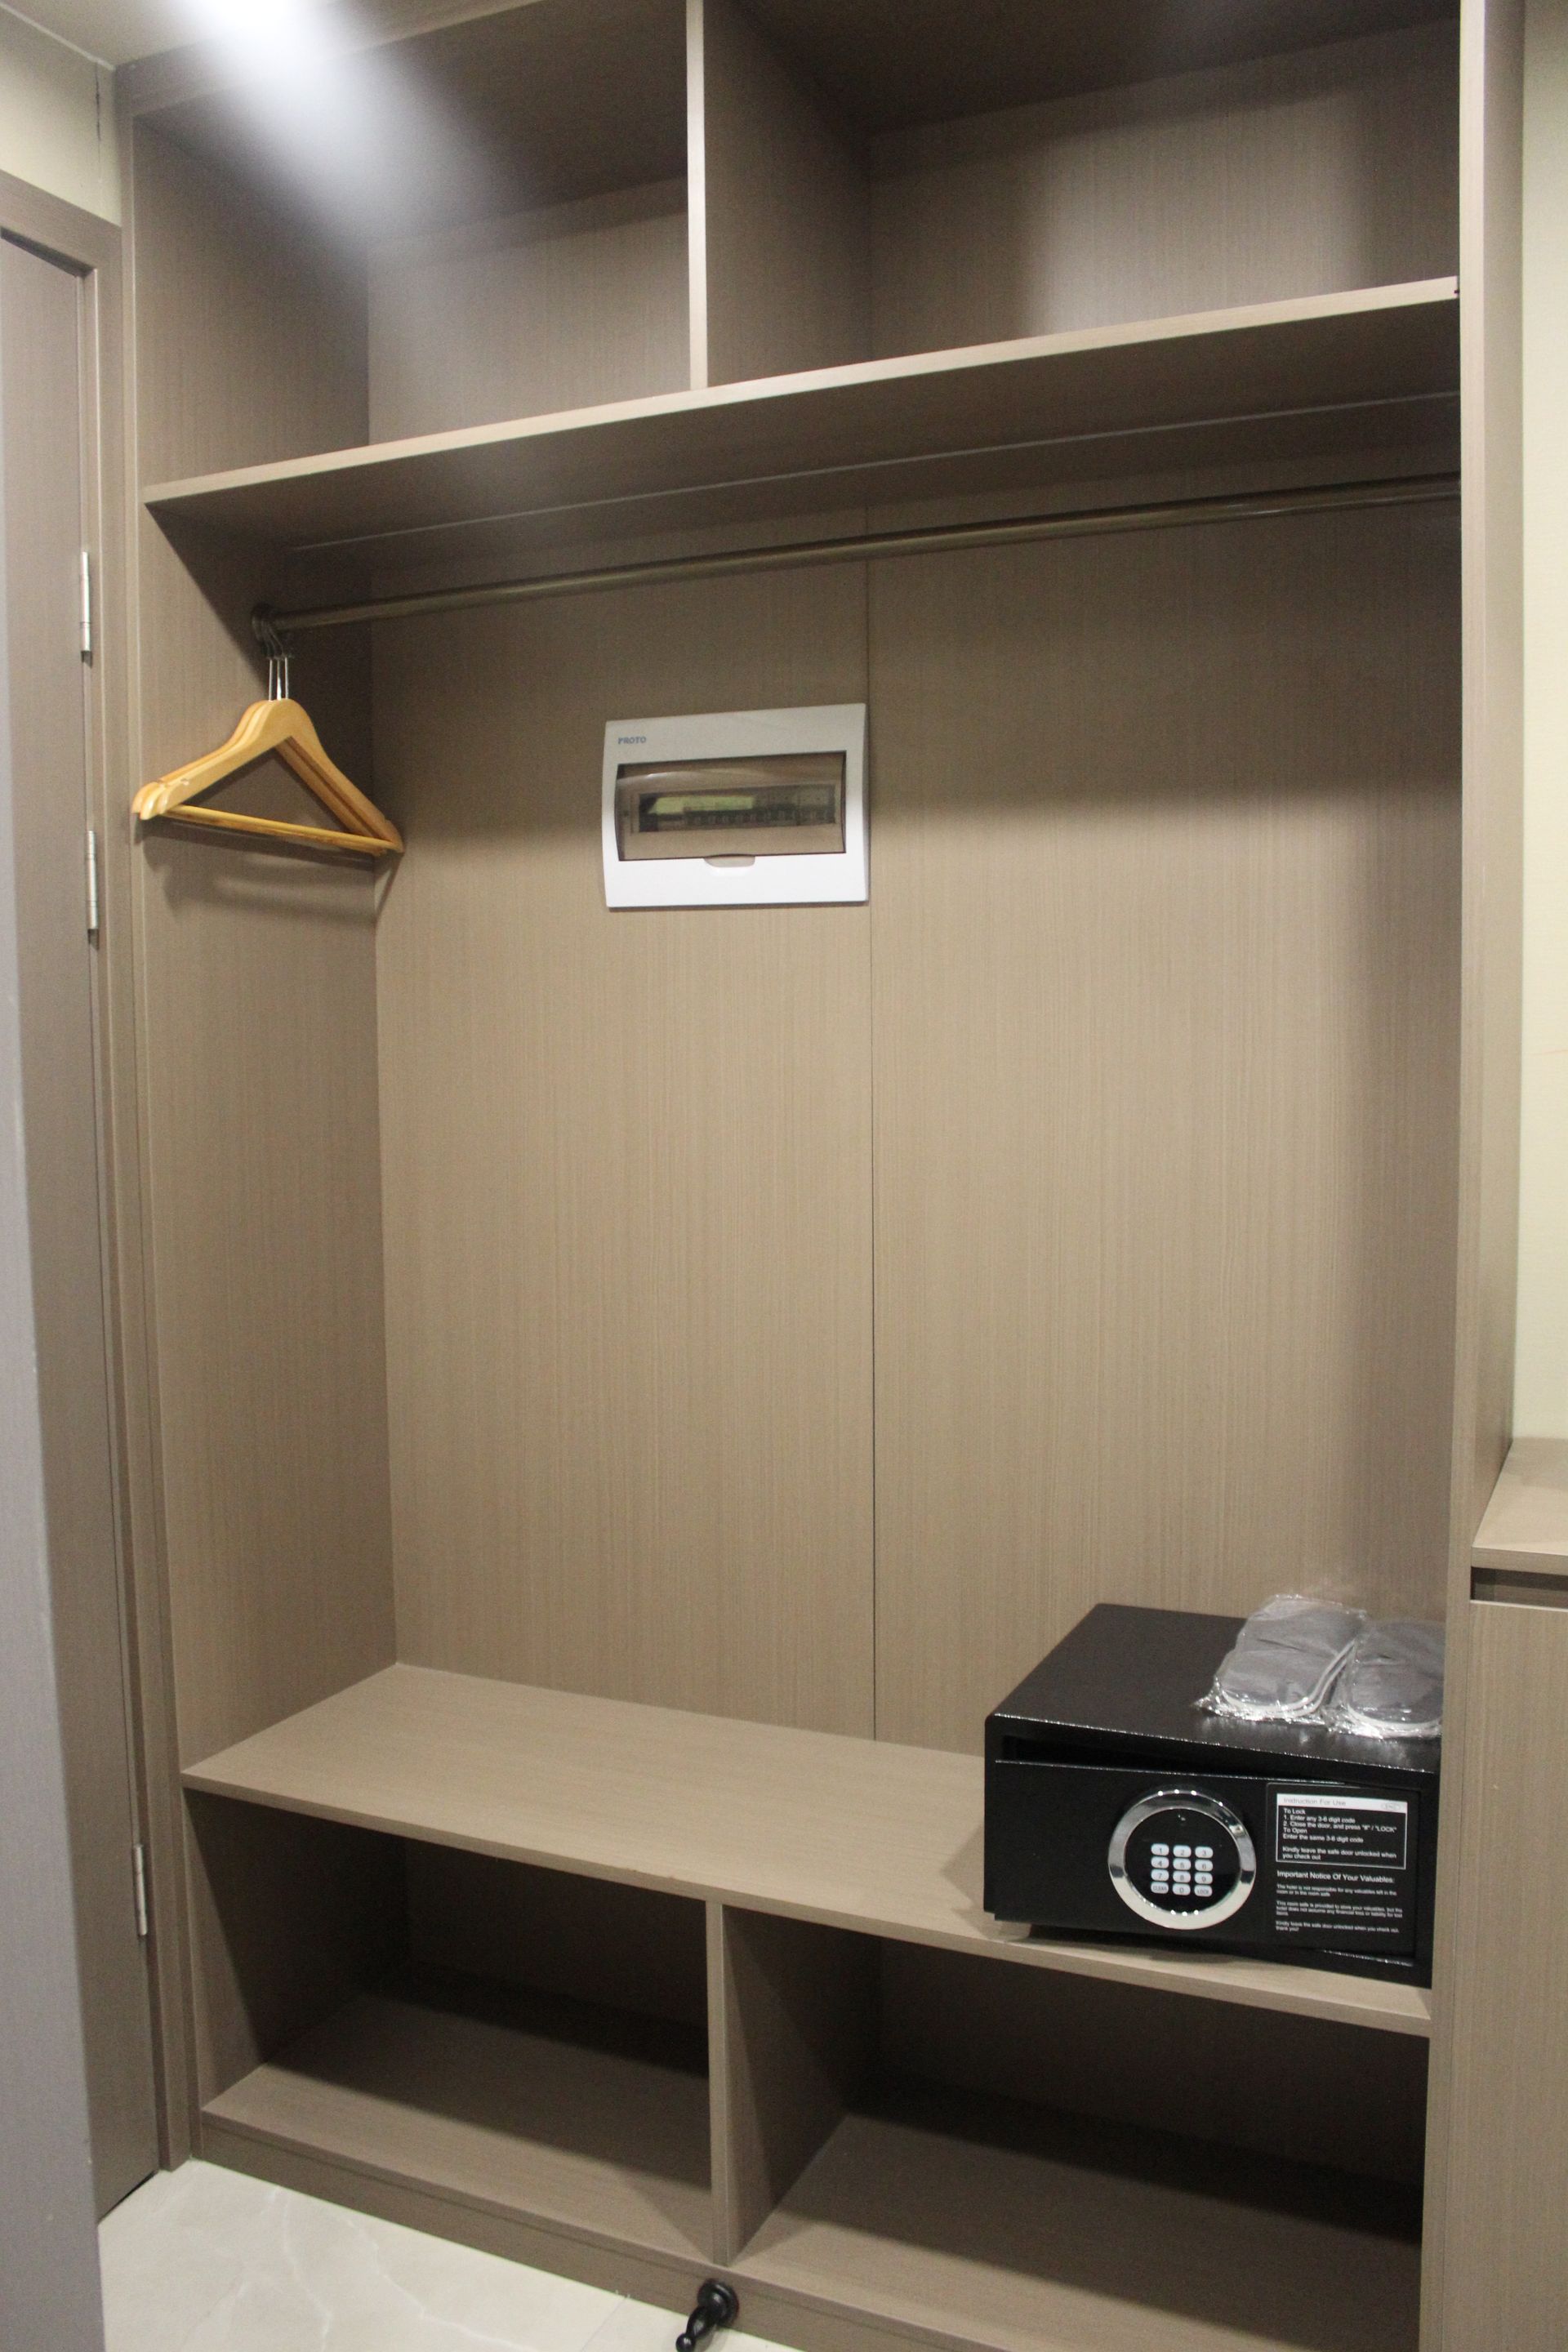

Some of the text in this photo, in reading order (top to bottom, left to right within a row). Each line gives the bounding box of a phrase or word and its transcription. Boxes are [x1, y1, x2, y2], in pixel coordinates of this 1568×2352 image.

[617, 736, 647, 745] PROTO
[1277, 1870, 1308, 1879] Important
[1310, 1872, 1331, 1880] Notice
[1343, 1873, 1358, 1882] Your
